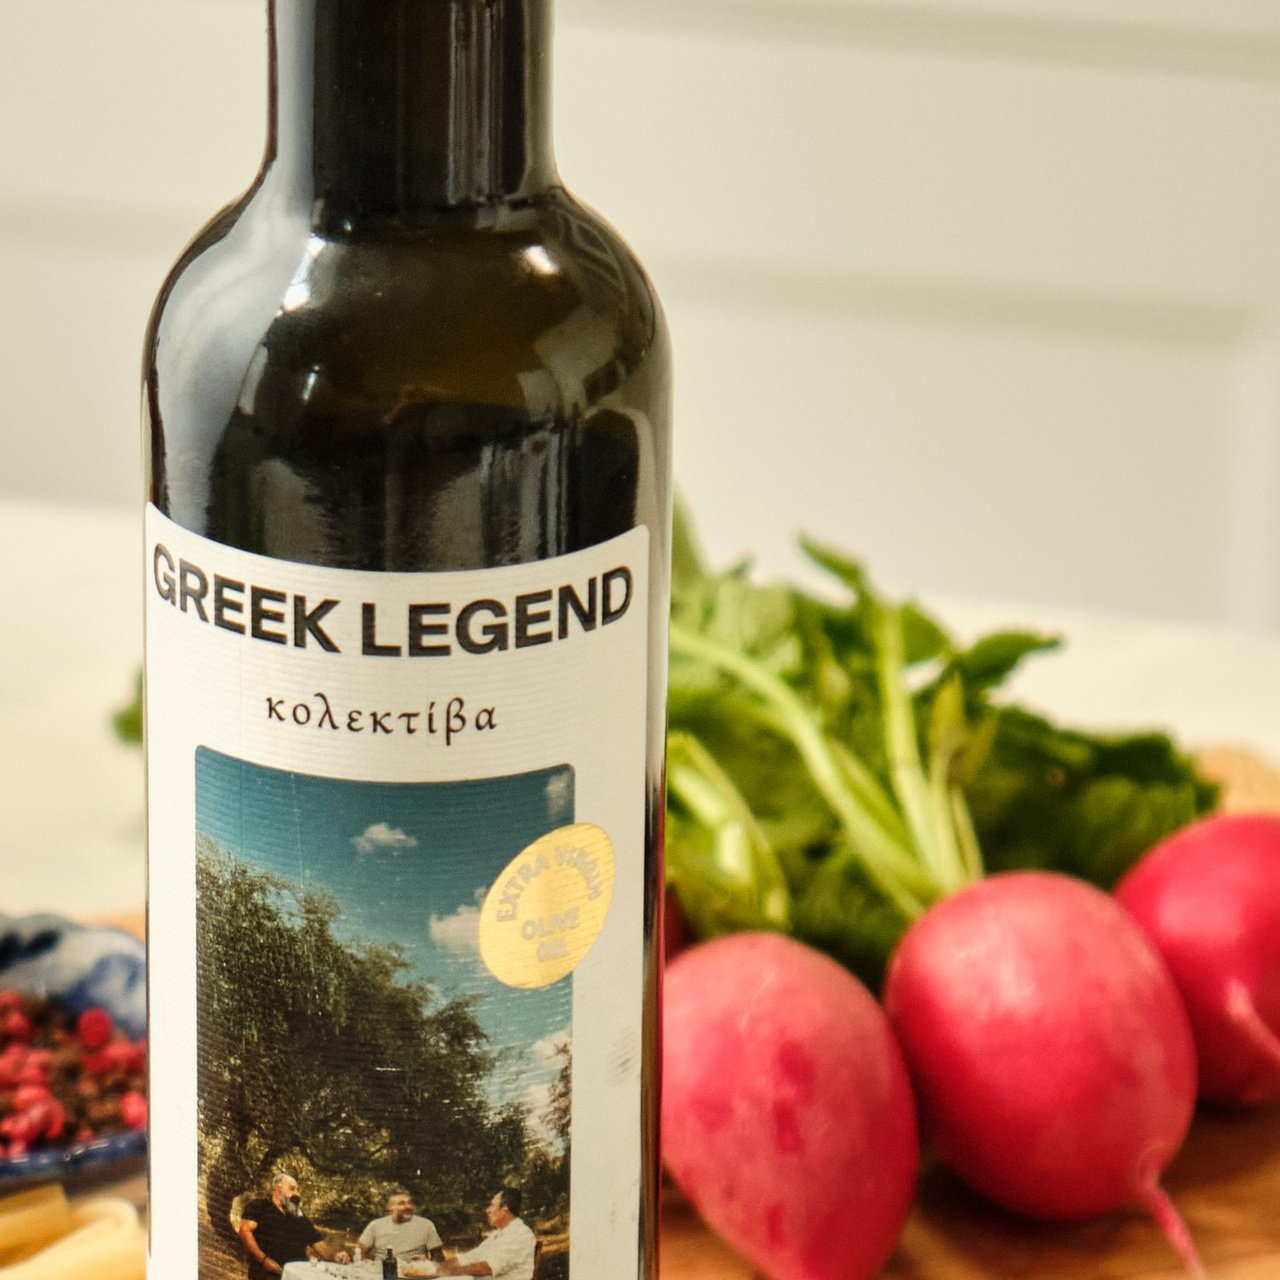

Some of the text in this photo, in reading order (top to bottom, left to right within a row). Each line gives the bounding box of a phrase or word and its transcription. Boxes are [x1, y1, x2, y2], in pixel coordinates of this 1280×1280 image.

[153, 542, 635, 658] GREEK LEGEND
[266, 692, 498, 746] κολεκτίβα
[496, 843, 604, 923] EXTRA VIRGIN
[521, 906, 581, 941] OLIVE
